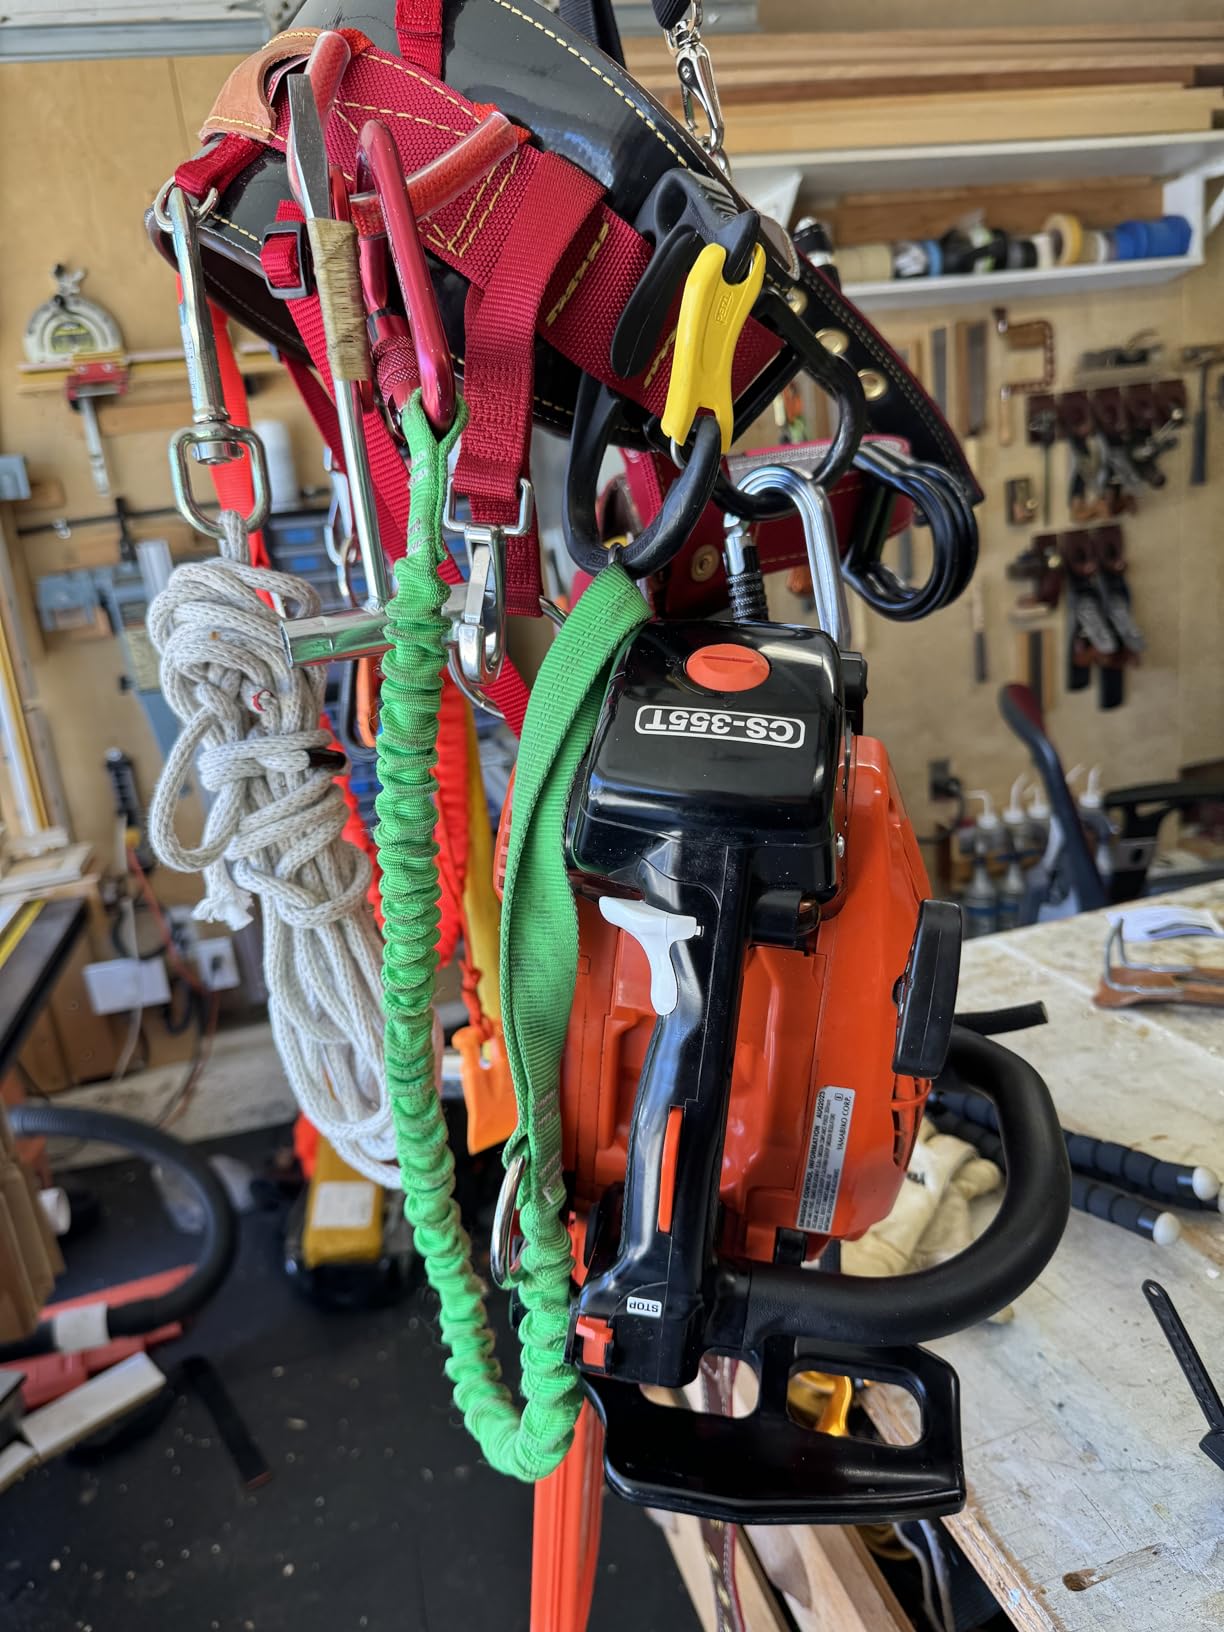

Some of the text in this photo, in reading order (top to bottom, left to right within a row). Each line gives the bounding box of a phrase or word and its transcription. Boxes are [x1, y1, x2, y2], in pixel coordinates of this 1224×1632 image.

[645, 709, 794, 742] CS-355T
[842, 1096, 852, 1116] CORP.
[808, 1125, 820, 1169] INFORMATION
[803, 1171, 814, 1199] CONTROL
[629, 1301, 659, 1313] STOP
